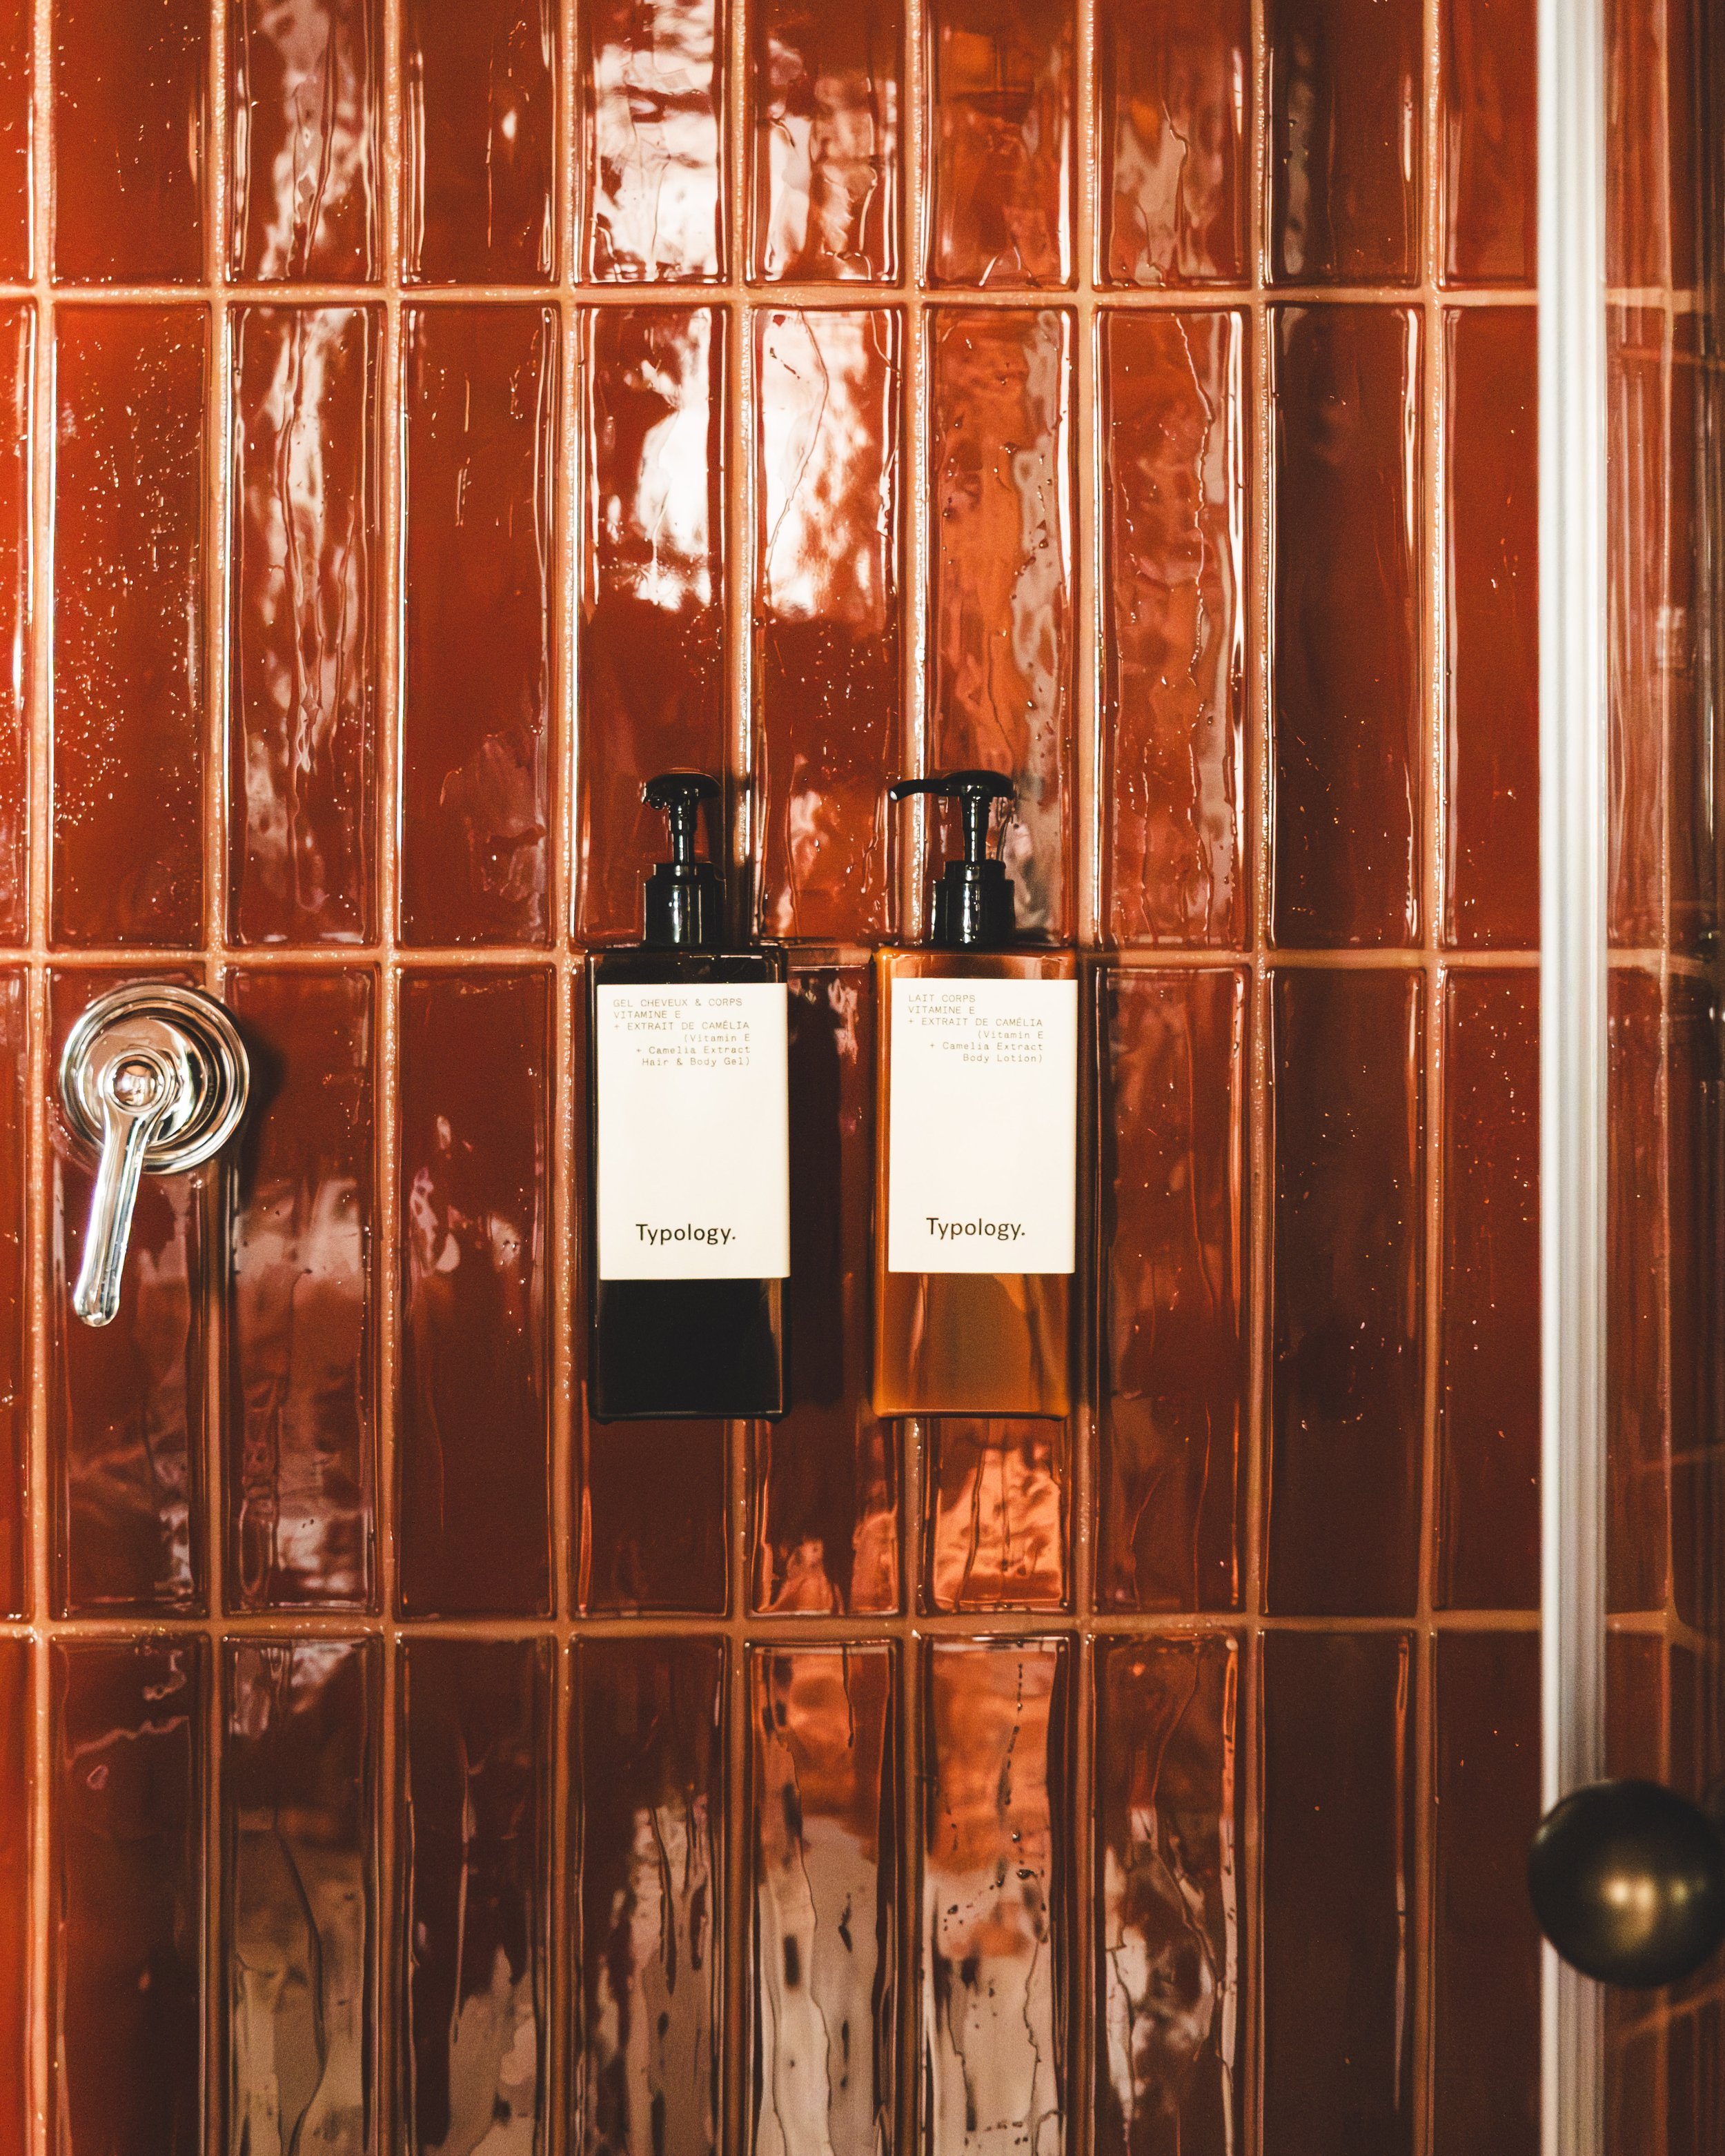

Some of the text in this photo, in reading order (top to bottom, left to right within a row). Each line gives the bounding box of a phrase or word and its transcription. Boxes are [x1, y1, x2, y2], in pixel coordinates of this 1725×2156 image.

[909, 1006, 961, 1014] VITAMINE
[614, 1011, 667, 1019] VITAMINE
[628, 1022, 673, 1030] EXTRAIT
[702, 1020, 750, 1029] CAMÉLIA
[996, 1017, 1043, 1027] CAMÉLIA
[684, 1034, 737, 1042] (Vitamin
[649, 1046, 696, 1054] Camelia
[943, 1042, 990, 1050] Camelia
[691, 1058, 717, 1067] Body
[724, 1057, 750, 1065] Gel)
[963, 1054, 1043, 1063] Body Lotion)
[926, 1218, 1025, 1240] Typology.
[635, 1223, 736, 1245] Typology.
